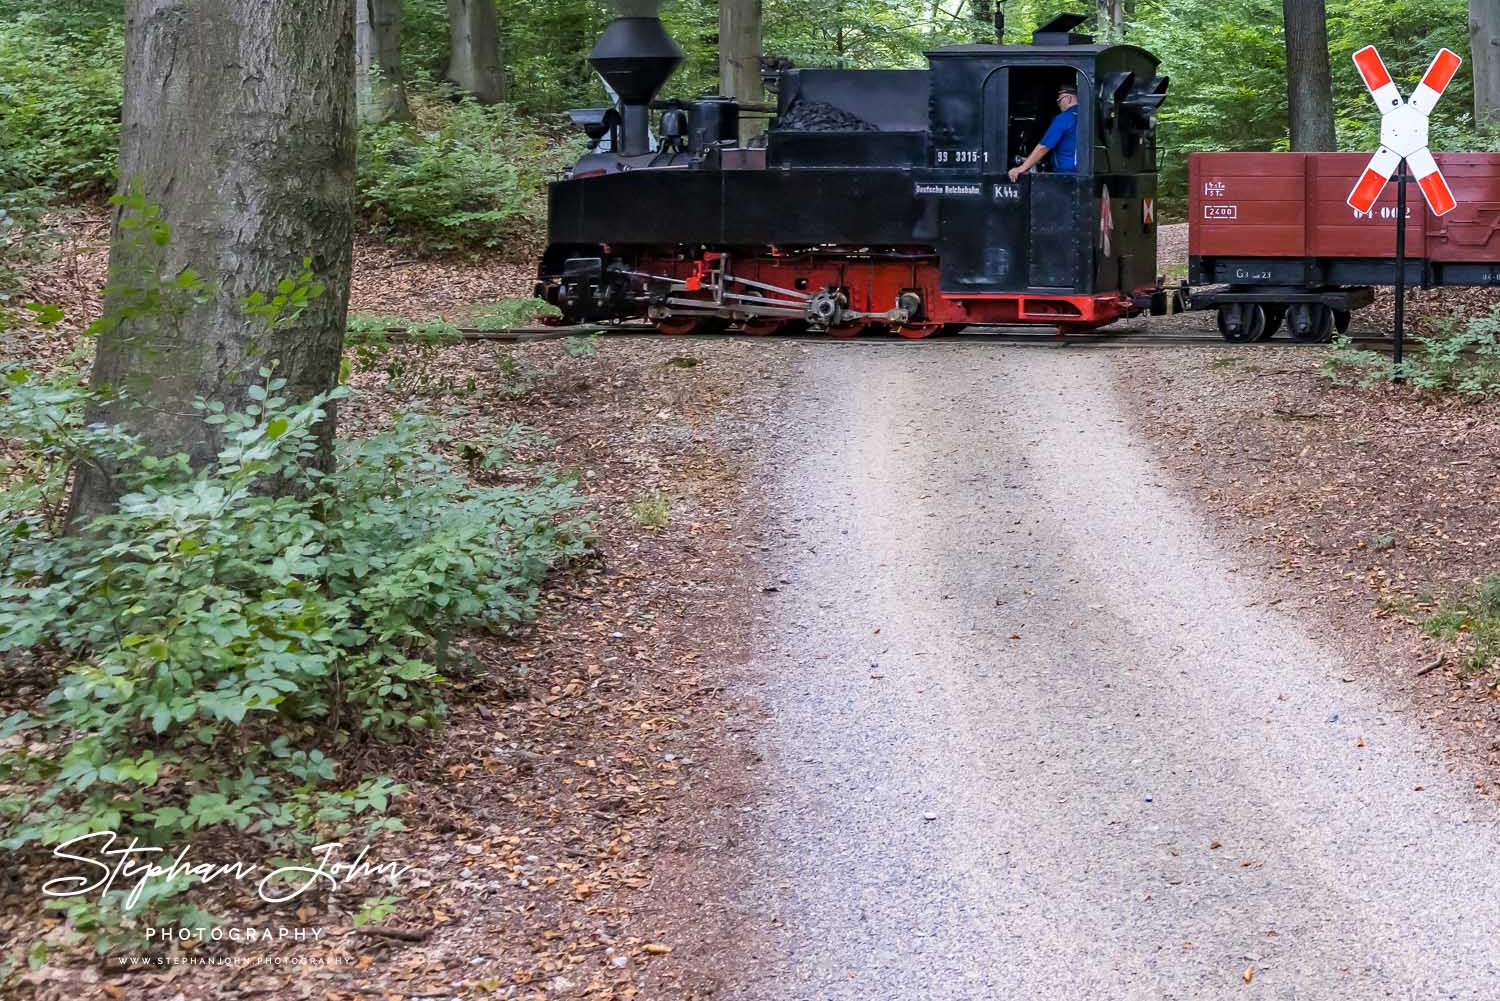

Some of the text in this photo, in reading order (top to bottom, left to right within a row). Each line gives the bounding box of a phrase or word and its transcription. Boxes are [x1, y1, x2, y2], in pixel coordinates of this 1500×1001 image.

[937, 151, 948, 163] 99
[915, 185, 980, 194] Deutsche Reichsbahn
[1209, 207, 1232, 216] 2400
